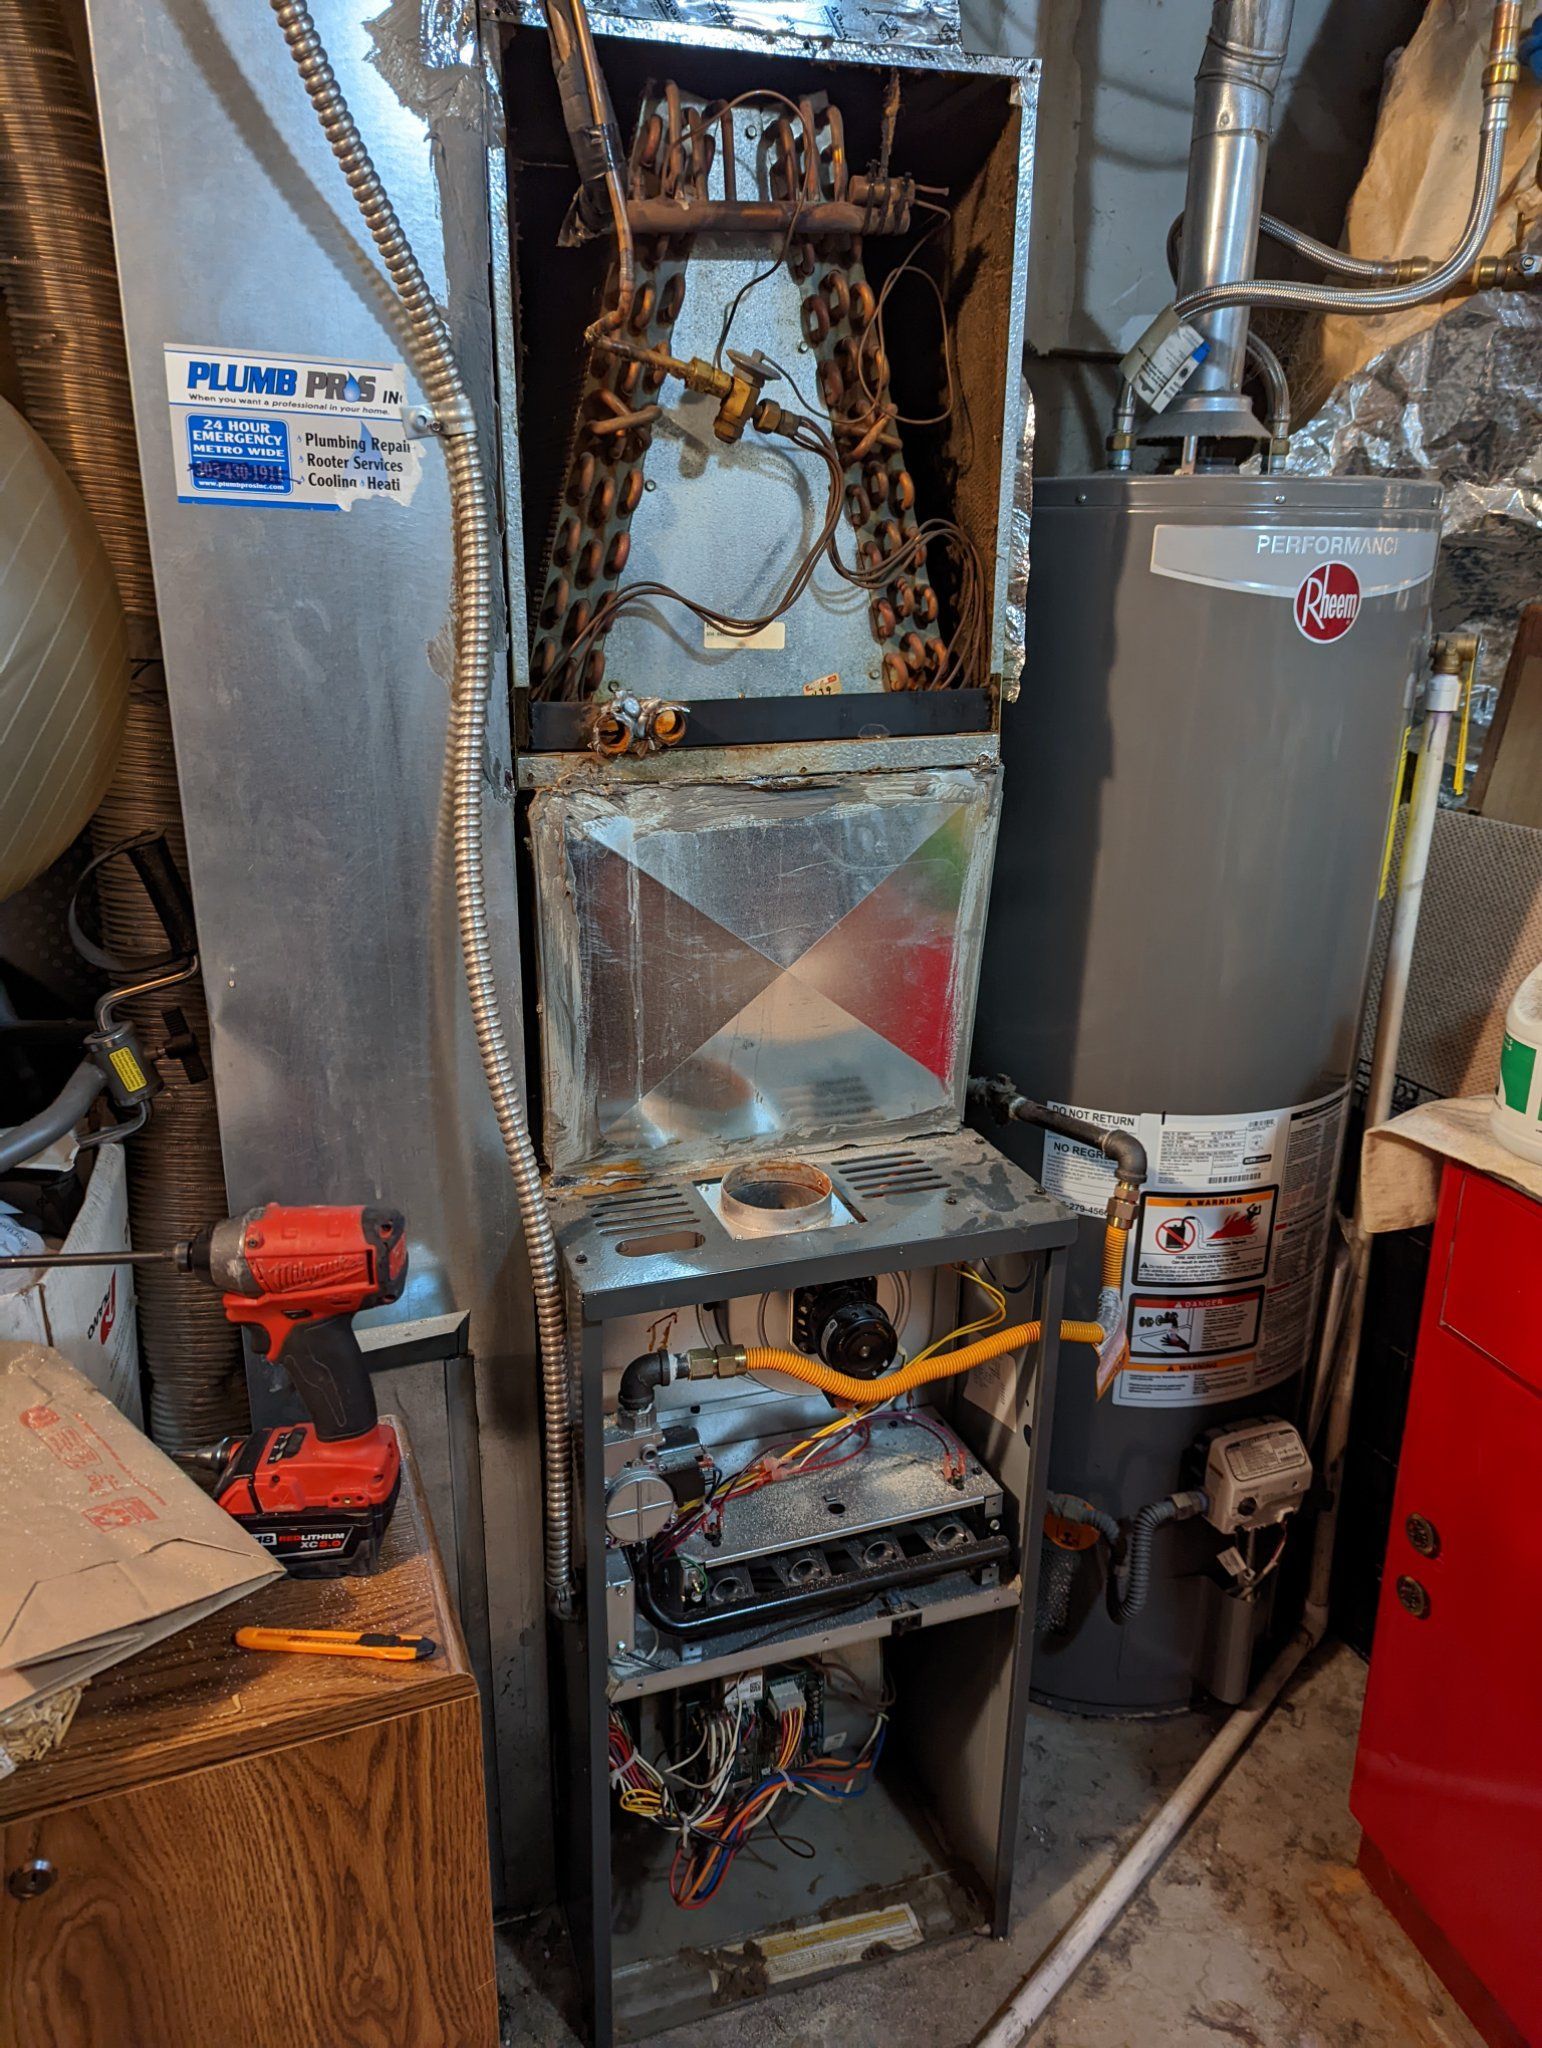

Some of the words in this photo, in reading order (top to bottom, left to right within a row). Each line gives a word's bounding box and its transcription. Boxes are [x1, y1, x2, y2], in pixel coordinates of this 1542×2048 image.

[187, 361, 298, 397] PLUMB
[188, 393, 216, 404] When
[218, 396, 237, 406] you
[238, 397, 261, 406] want
[271, 399, 328, 411] professional
[329, 403, 338, 411] in
[339, 405, 360, 414] your
[362, 406, 391, 416] home.
[203, 419, 223, 431] 24
[228, 420, 271, 434] HOUR
[193, 430, 284, 447] EMERGENCY
[305, 433, 366, 453] Plumbing
[193, 444, 244, 456] METRO
[247, 447, 285, 458] WIDE
[307, 453, 350, 470] Rooter
[353, 458, 404, 473] Services
[198, 480, 285, 491] www.plumbprosinc.com
[1301, 564, 1358, 630] Rheem
[1068, 1108, 1090, 1121] NOT
[1092, 1112, 1135, 1127] RETURN
[1053, 1141, 1070, 1153] NO
[1196, 1197, 1243, 1207] WARNING
[1185, 1298, 1224, 1309] DANGER
[1178, 1362, 1218, 1373] WARNING
[278, 1532, 345, 1543] REDLITHIUM
